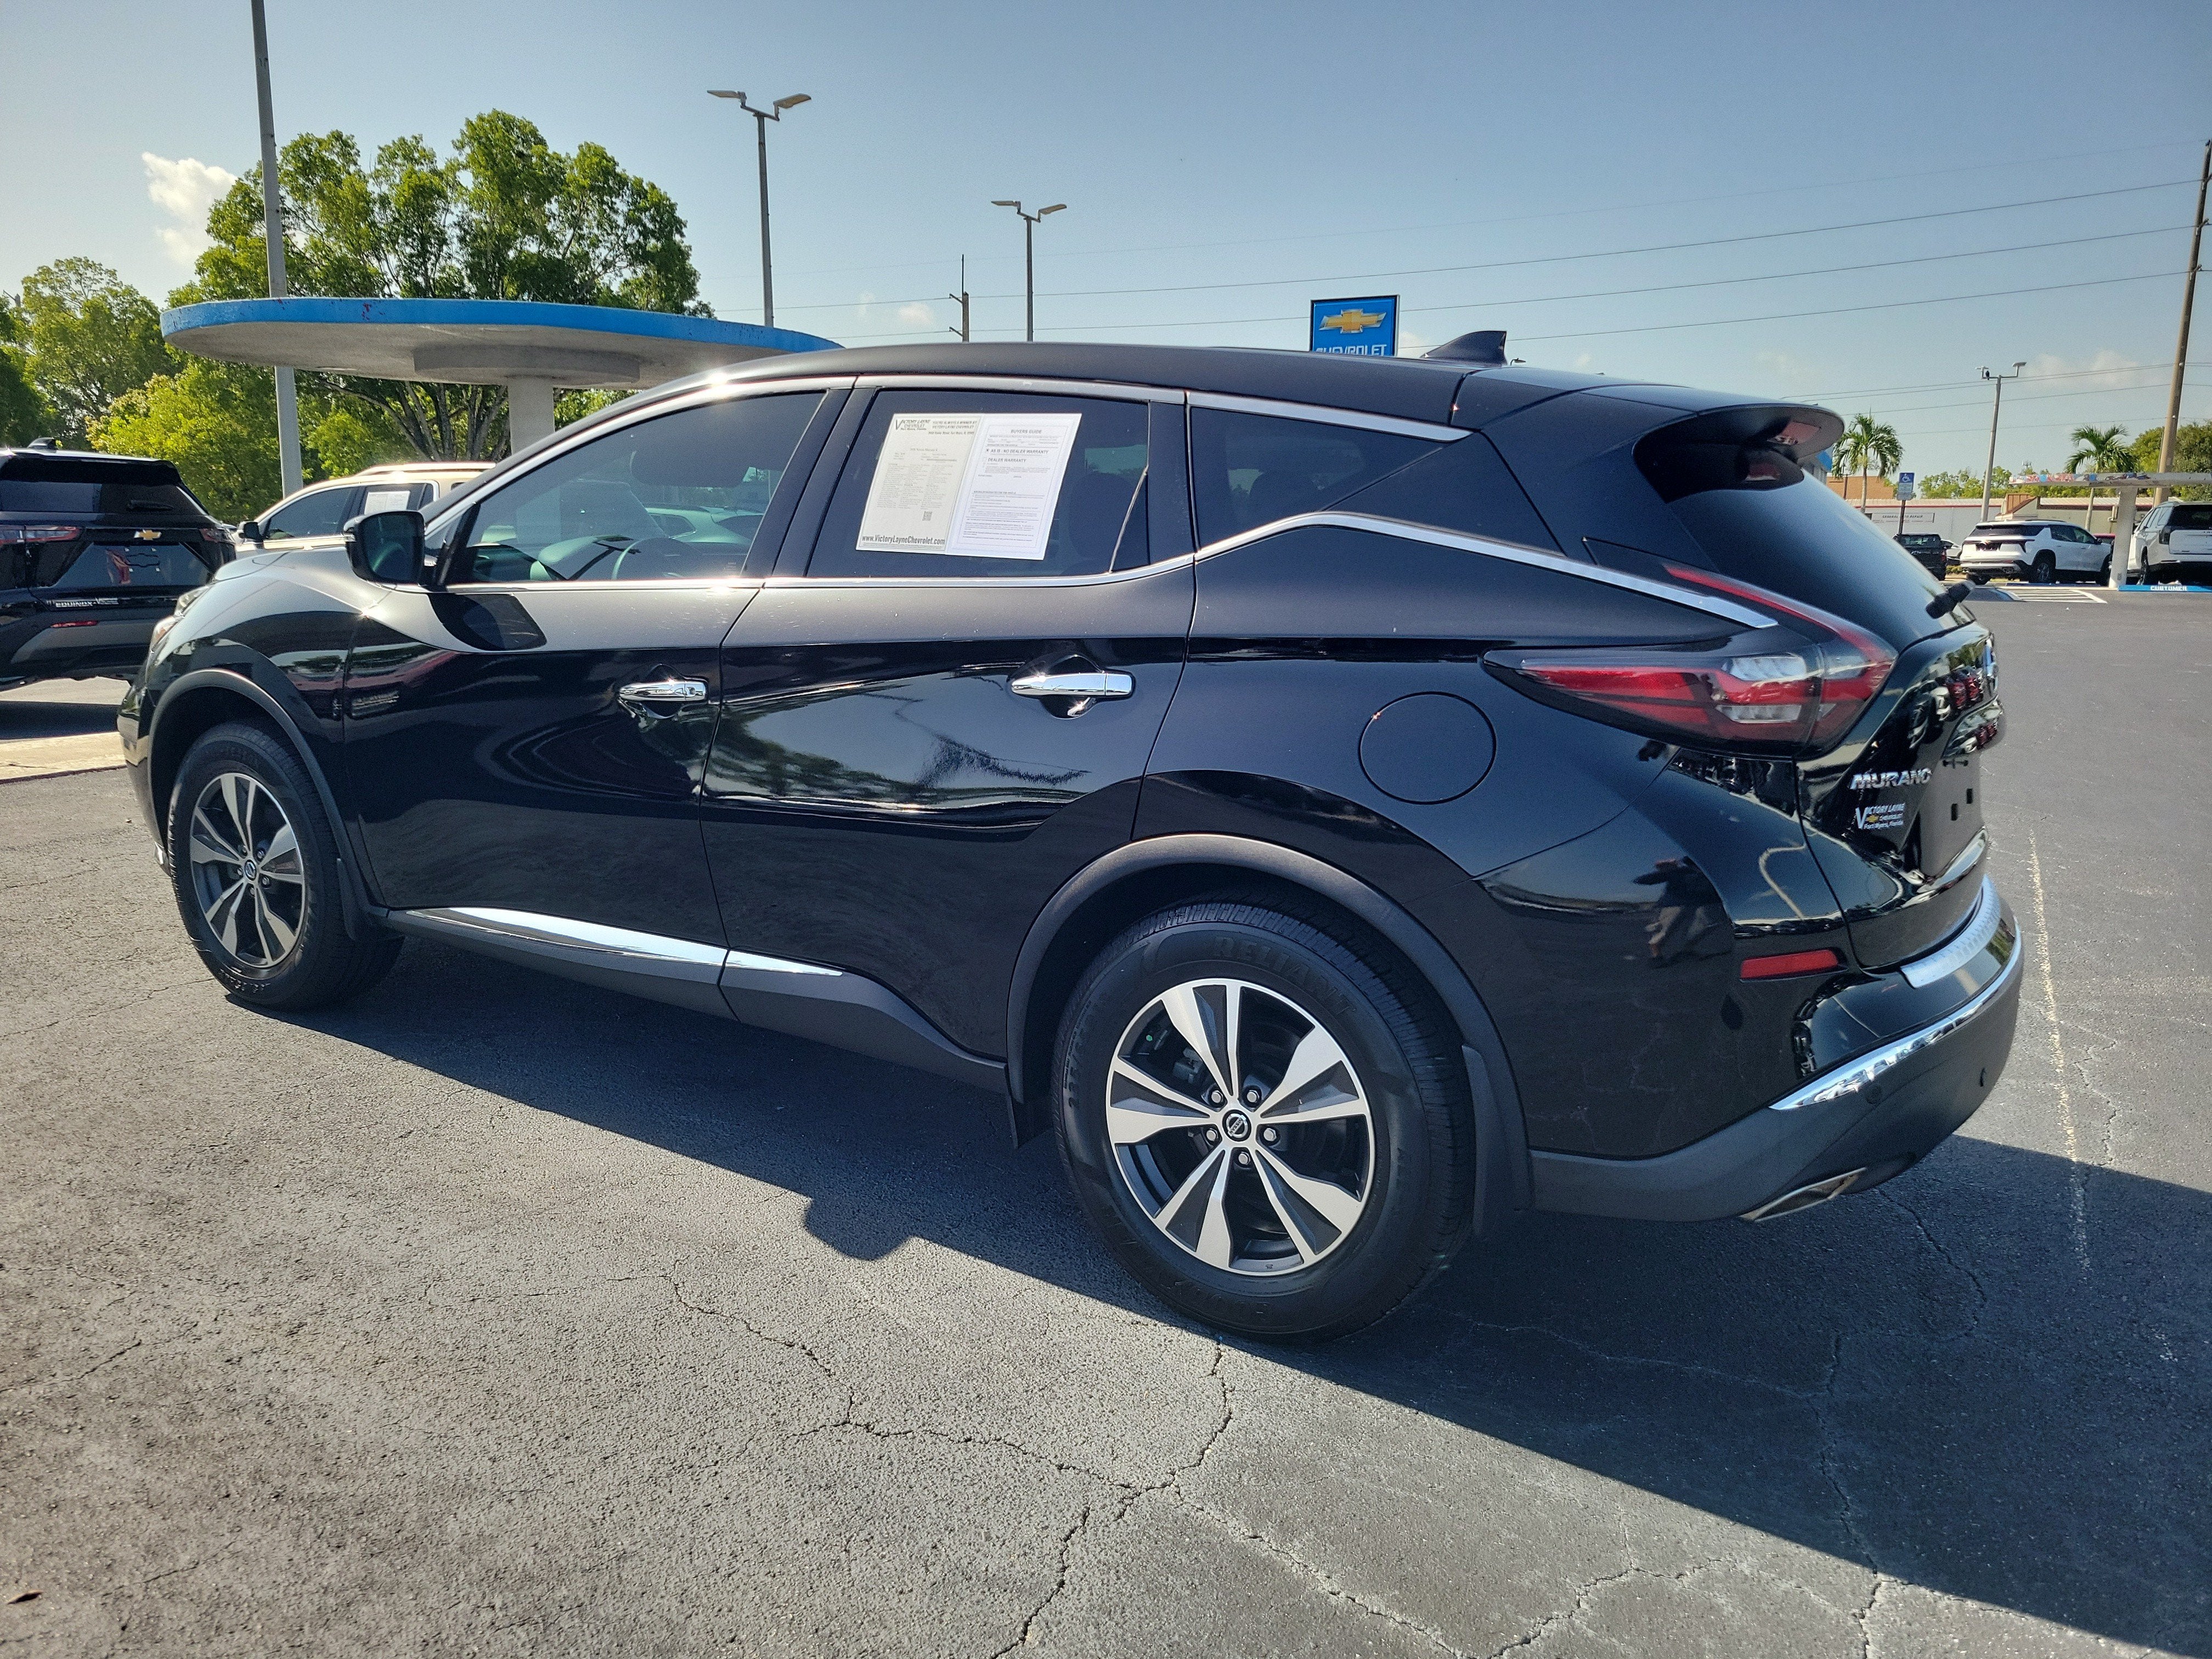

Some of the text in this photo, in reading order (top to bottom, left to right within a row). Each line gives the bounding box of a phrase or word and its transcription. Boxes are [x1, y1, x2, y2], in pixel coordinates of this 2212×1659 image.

[862, 534, 945, 545] www.VictoryLayneChevrolet.com
[1850, 768, 1932, 789] MURANO
[1229, 1117, 1243, 1135] NISSAN
